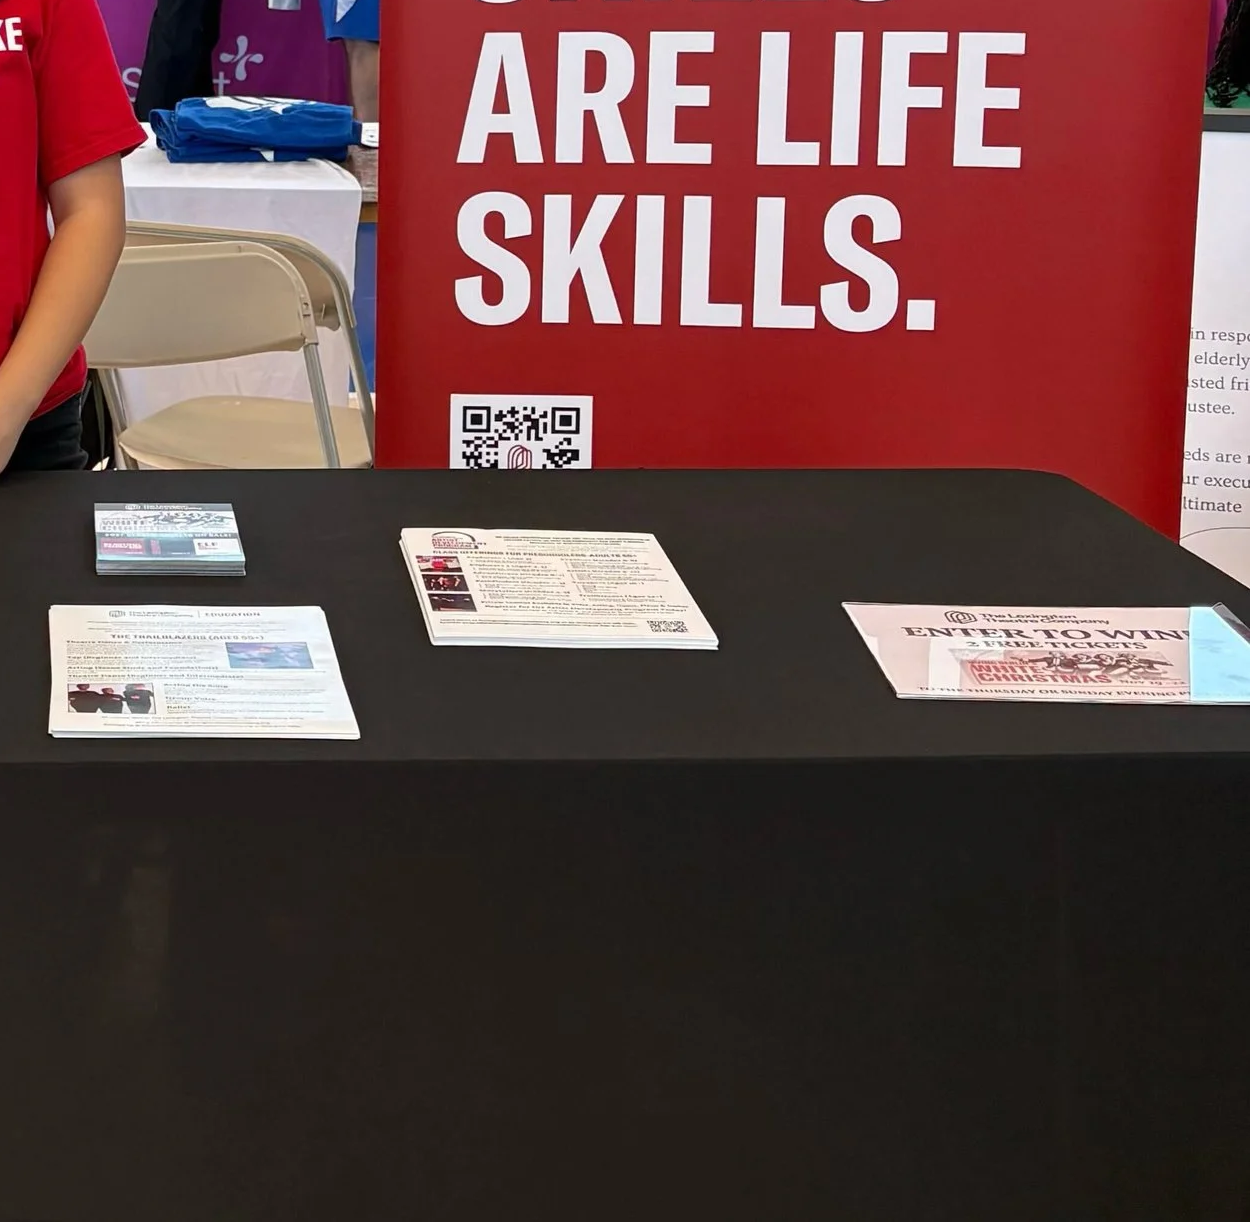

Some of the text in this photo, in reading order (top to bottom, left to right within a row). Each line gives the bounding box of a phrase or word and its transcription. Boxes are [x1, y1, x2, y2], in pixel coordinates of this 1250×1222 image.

[456, 31, 1026, 168] ARE LIFE
[454, 191, 936, 332] SKILLS.
[1194, 352, 1250, 371] elderly
[1189, 376, 1225, 390] sted
[1188, 402, 1235, 415] ustee.
[1215, 453, 1241, 464] are
[901, 627, 1033, 640] ENTER
[1034, 629, 1092, 640] TO
[1044, 642, 1148, 650] TICKETS
[971, 665, 1043, 675] WHITE
[978, 674, 1112, 684] CHRISTMAS
